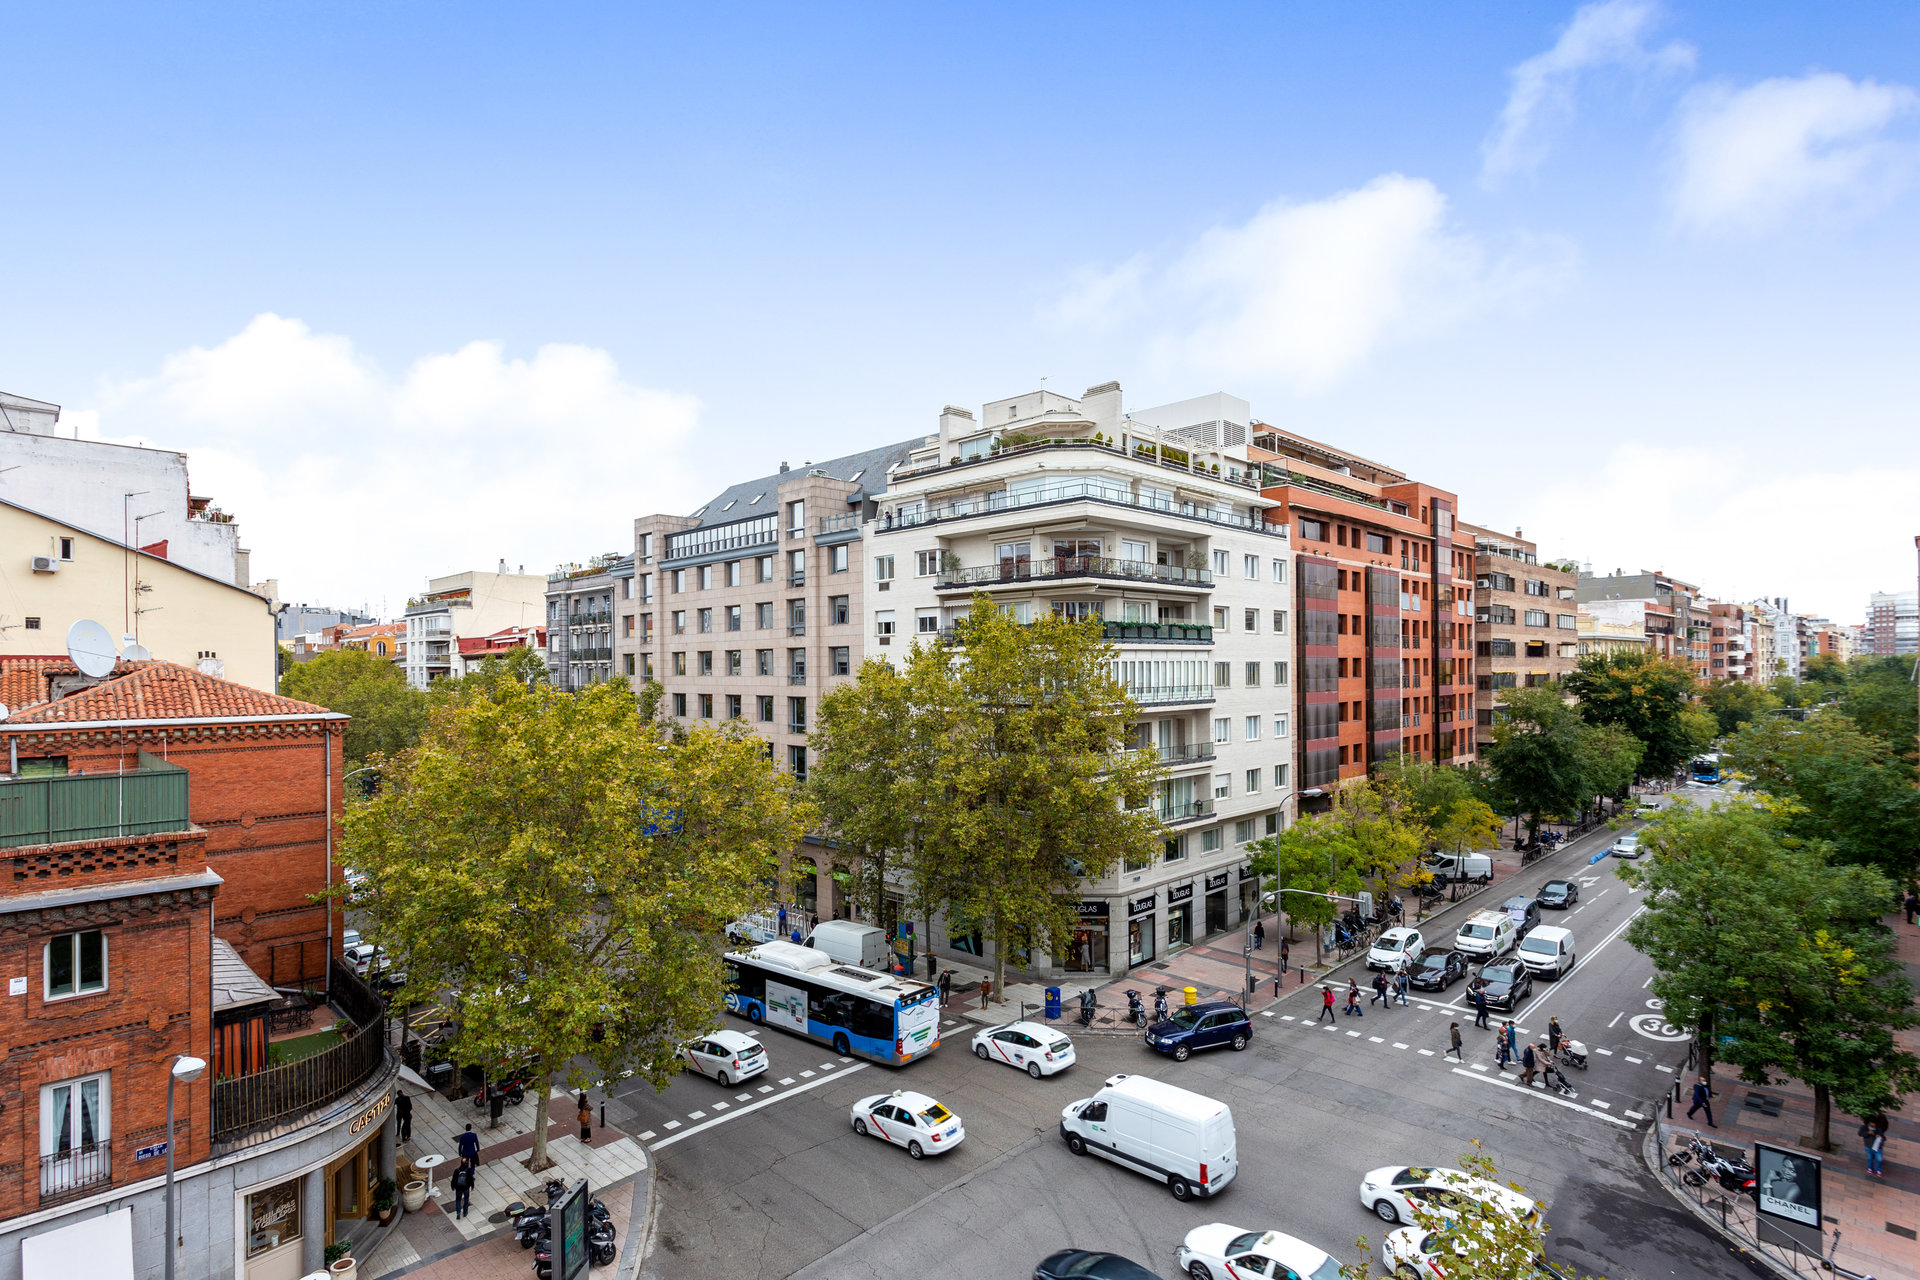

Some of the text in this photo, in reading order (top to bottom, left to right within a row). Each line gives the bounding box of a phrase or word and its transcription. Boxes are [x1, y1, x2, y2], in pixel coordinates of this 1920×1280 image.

[1209, 877, 1226, 888] DOUGLAS
[1172, 888, 1191, 900] DOUGLAS
[1133, 900, 1153, 912] DOUGLAS
[1643, 1019, 1679, 1036] 30
[1766, 1197, 1811, 1215] CHANEL
